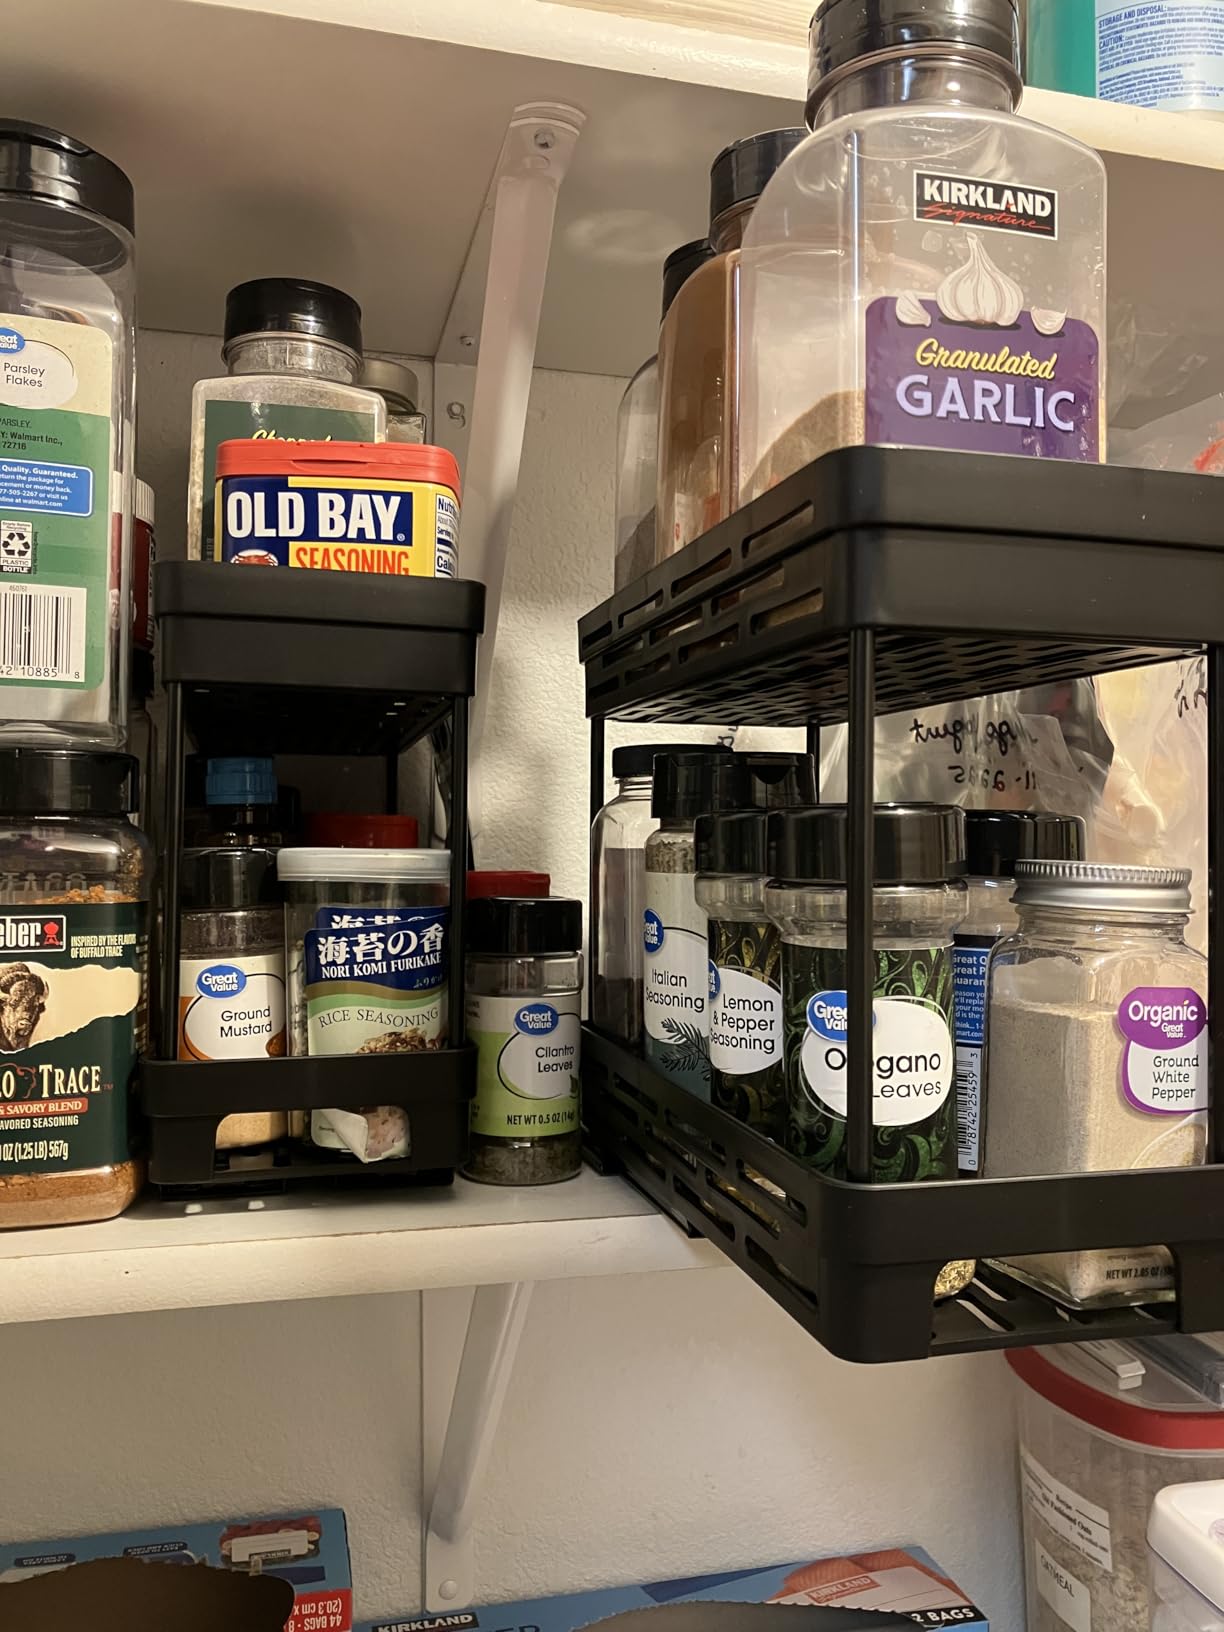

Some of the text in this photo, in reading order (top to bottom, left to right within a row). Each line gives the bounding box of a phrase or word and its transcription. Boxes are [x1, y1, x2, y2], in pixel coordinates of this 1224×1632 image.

[1098, 13, 1123, 29] STORAGE
[1124, 9, 1136, 20] AND
[923, 178, 1052, 218] KIRKLAND
[923, 202, 1052, 231] Signature
[0, 334, 18, 344] eat
[914, 337, 1058, 380] Granulated
[3, 362, 46, 378] Parsley
[6, 374, 43, 388] Flakes
[895, 373, 1076, 432] GARLIC
[0, 417, 32, 429] ARSLEY.
[10, 431, 44, 443] Walmart
[32, 467, 79, 480] Guaranteed.
[226, 491, 402, 541] OLD BAY
[295, 546, 410, 577] SEASONING
[21, 666, 58, 678] 10885
[74, 671, 80, 680] 8
[70, 935, 98, 947] INSPIRED
[98, 935, 107, 946] BY
[107, 934, 118, 946] THE
[70, 945, 124, 958] OF BUFFALO TRACE
[321, 951, 442, 979] NORI KOMI FURIKAKE
[201, 971, 239, 985] Great
[651, 968, 688, 988] Italian
[210, 983, 239, 992] Value
[644, 987, 705, 1013] Seasoning
[723, 993, 774, 1012] Lemon
[220, 1005, 271, 1022] Ground
[318, 1008, 351, 1028] RICE
[356, 1006, 439, 1028] SEASONING
[519, 1010, 552, 1023] Great
[1127, 1000, 1198, 1028] Organic
[220, 1020, 273, 1038] Mustard
[527, 1021, 552, 1030] Value
[713, 1011, 775, 1034] & Pepper
[1161, 1022, 1184, 1033] Great
[710, 1027, 775, 1055] Seasoning
[535, 1045, 575, 1059] Cilantro
[970, 1051, 979, 1059] 3
[537, 1060, 573, 1073] Leaves
[824, 1047, 942, 1080] Ogano
[1152, 1055, 1199, 1068] Ground
[38, 1064, 101, 1098] TRACE
[1152, 1070, 1190, 1083] White
[967, 1072, 978, 1107] 25459
[1151, 1087, 1196, 1102] Pepper
[6, 1103, 47, 1116] SAVORY
[48, 1100, 83, 1113] BLEND
[0, 1115, 79, 1131] AVORED SEASONING
[506, 1114, 523, 1126] NET
[524, 1113, 537, 1125] WT
[538, 1112, 551, 1125] 0.5
[551, 1111, 561, 1123] OZ
[967, 1110, 977, 1146] 78742
[2, 1143, 14, 1161] OZ
[48, 1140, 69, 1160] 567g
[1106, 1269, 1120, 1280] NET
[1121, 1268, 1133, 1279] WT
[1039, 1554, 1076, 1598] OATMEAL
[808, 1576, 872, 1599] KIRKLAND
[301, 1602, 316, 1615] cm
[318, 1597, 343, 1615] (20.3
[928, 1606, 976, 1621] BAGS
[303, 1615, 327, 1631] BAGS
[329, 1613, 342, 1628] 44
[376, 1613, 473, 1632] KIRKLAND
